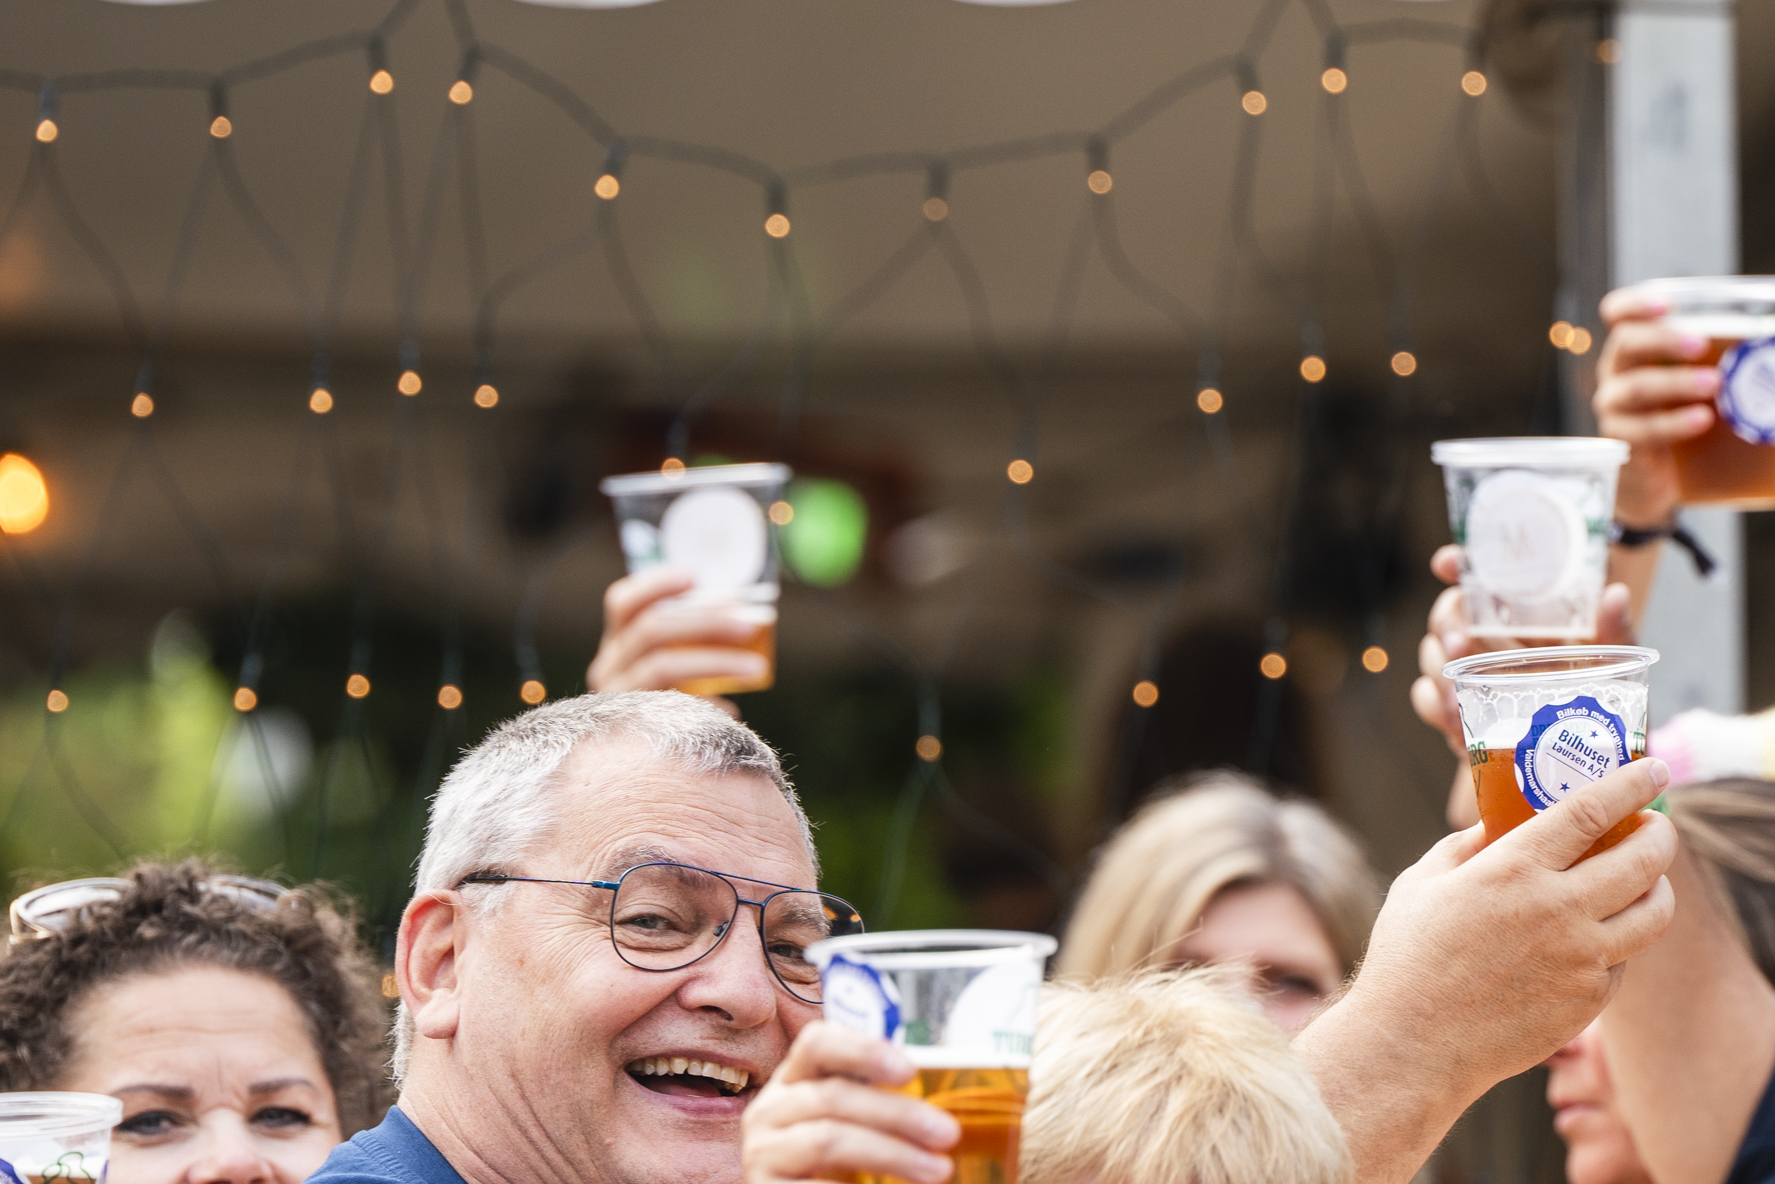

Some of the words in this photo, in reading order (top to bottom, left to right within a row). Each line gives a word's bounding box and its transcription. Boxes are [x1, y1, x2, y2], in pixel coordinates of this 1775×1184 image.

[1558, 729, 1610, 768] Bilhuset
[1591, 710, 1610, 726] med
[1608, 723, 1625, 761] tryghed
[1524, 749, 1554, 807] Valdemarshaa
[1552, 742, 1587, 768] Laursen
[1587, 763, 1605, 778] A/S
